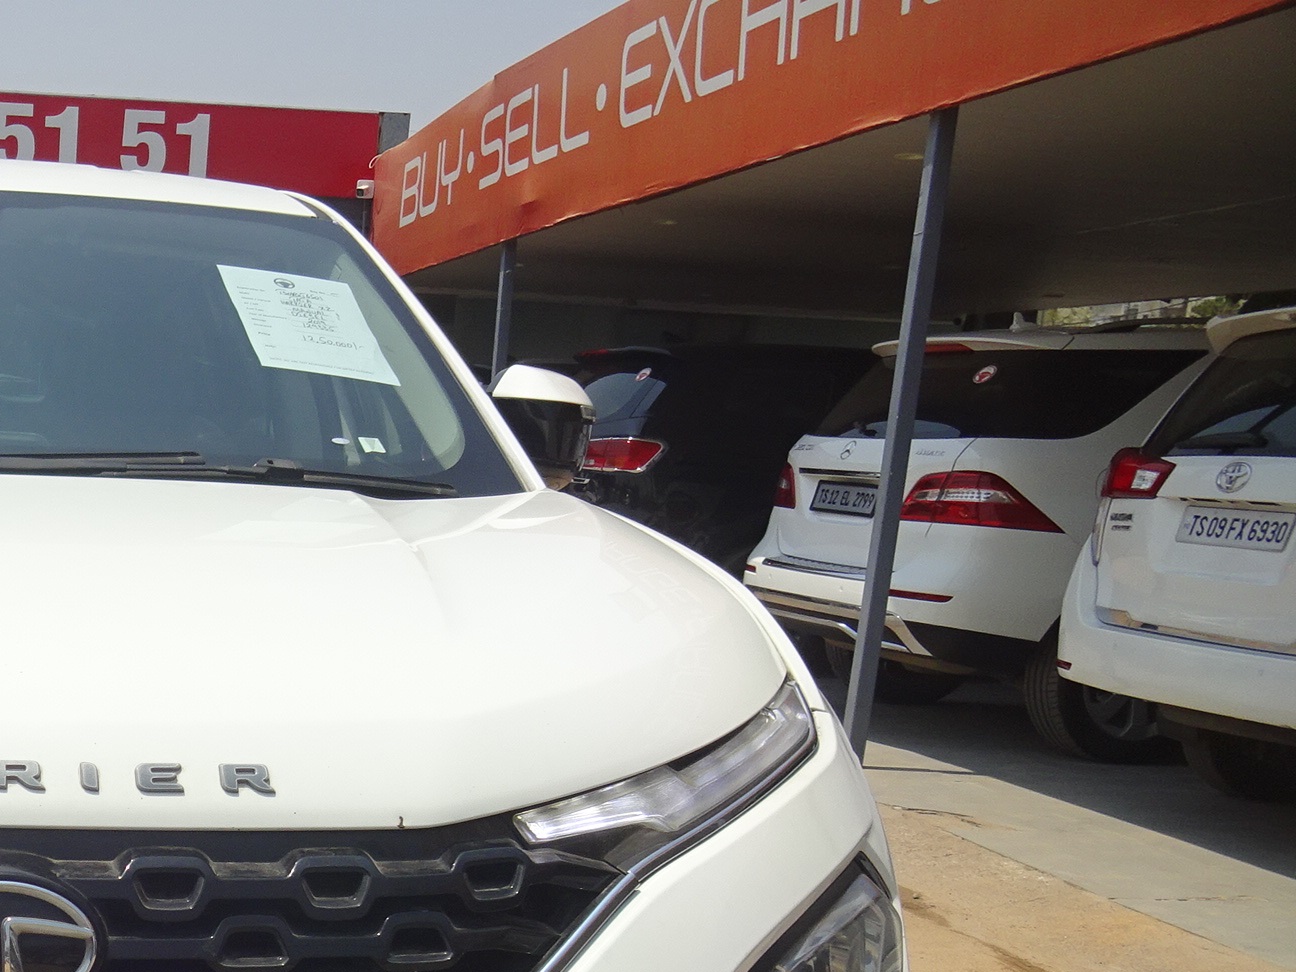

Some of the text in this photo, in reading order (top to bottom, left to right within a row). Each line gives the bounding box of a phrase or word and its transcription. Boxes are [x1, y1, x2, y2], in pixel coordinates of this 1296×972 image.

[119, 109, 211, 178] 51
[399, 128, 464, 228] BUY
[479, 68, 590, 190] SELL
